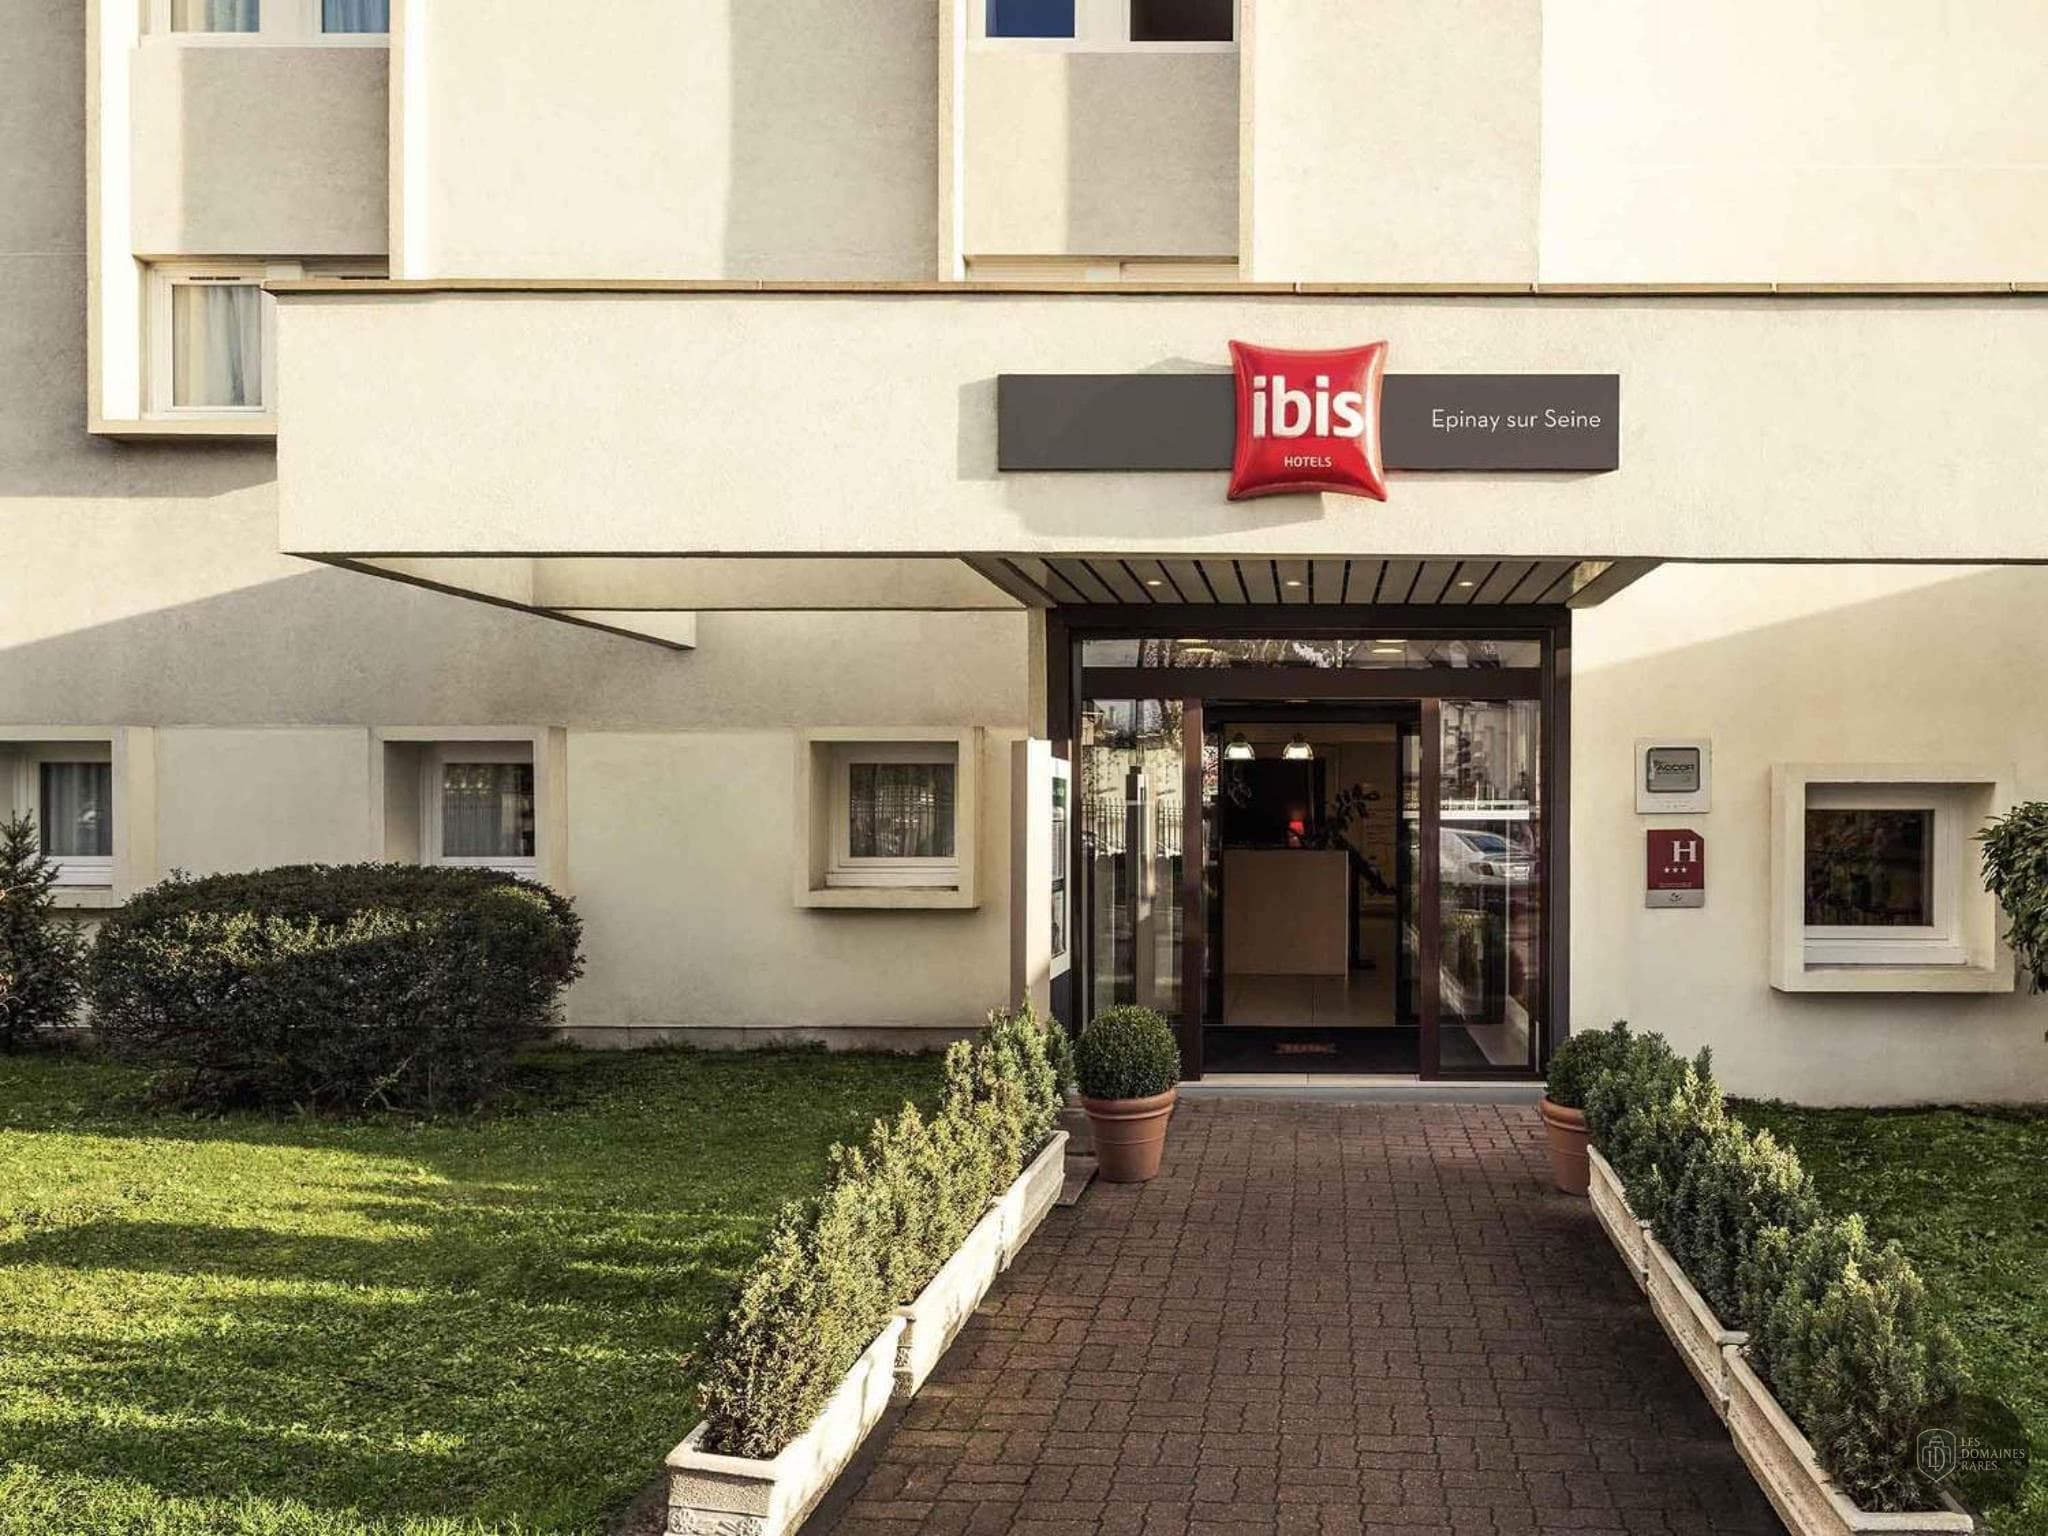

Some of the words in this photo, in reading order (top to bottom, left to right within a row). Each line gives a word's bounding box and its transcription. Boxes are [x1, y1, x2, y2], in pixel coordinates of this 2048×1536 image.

[1253, 375, 1365, 438] ibis
[1432, 408, 1500, 433] Epinay
[1507, 415, 1538, 430] sur
[1544, 408, 1601, 430] Seine
[1284, 455, 1332, 468] HOTELS
[1673, 841, 1697, 862] H
